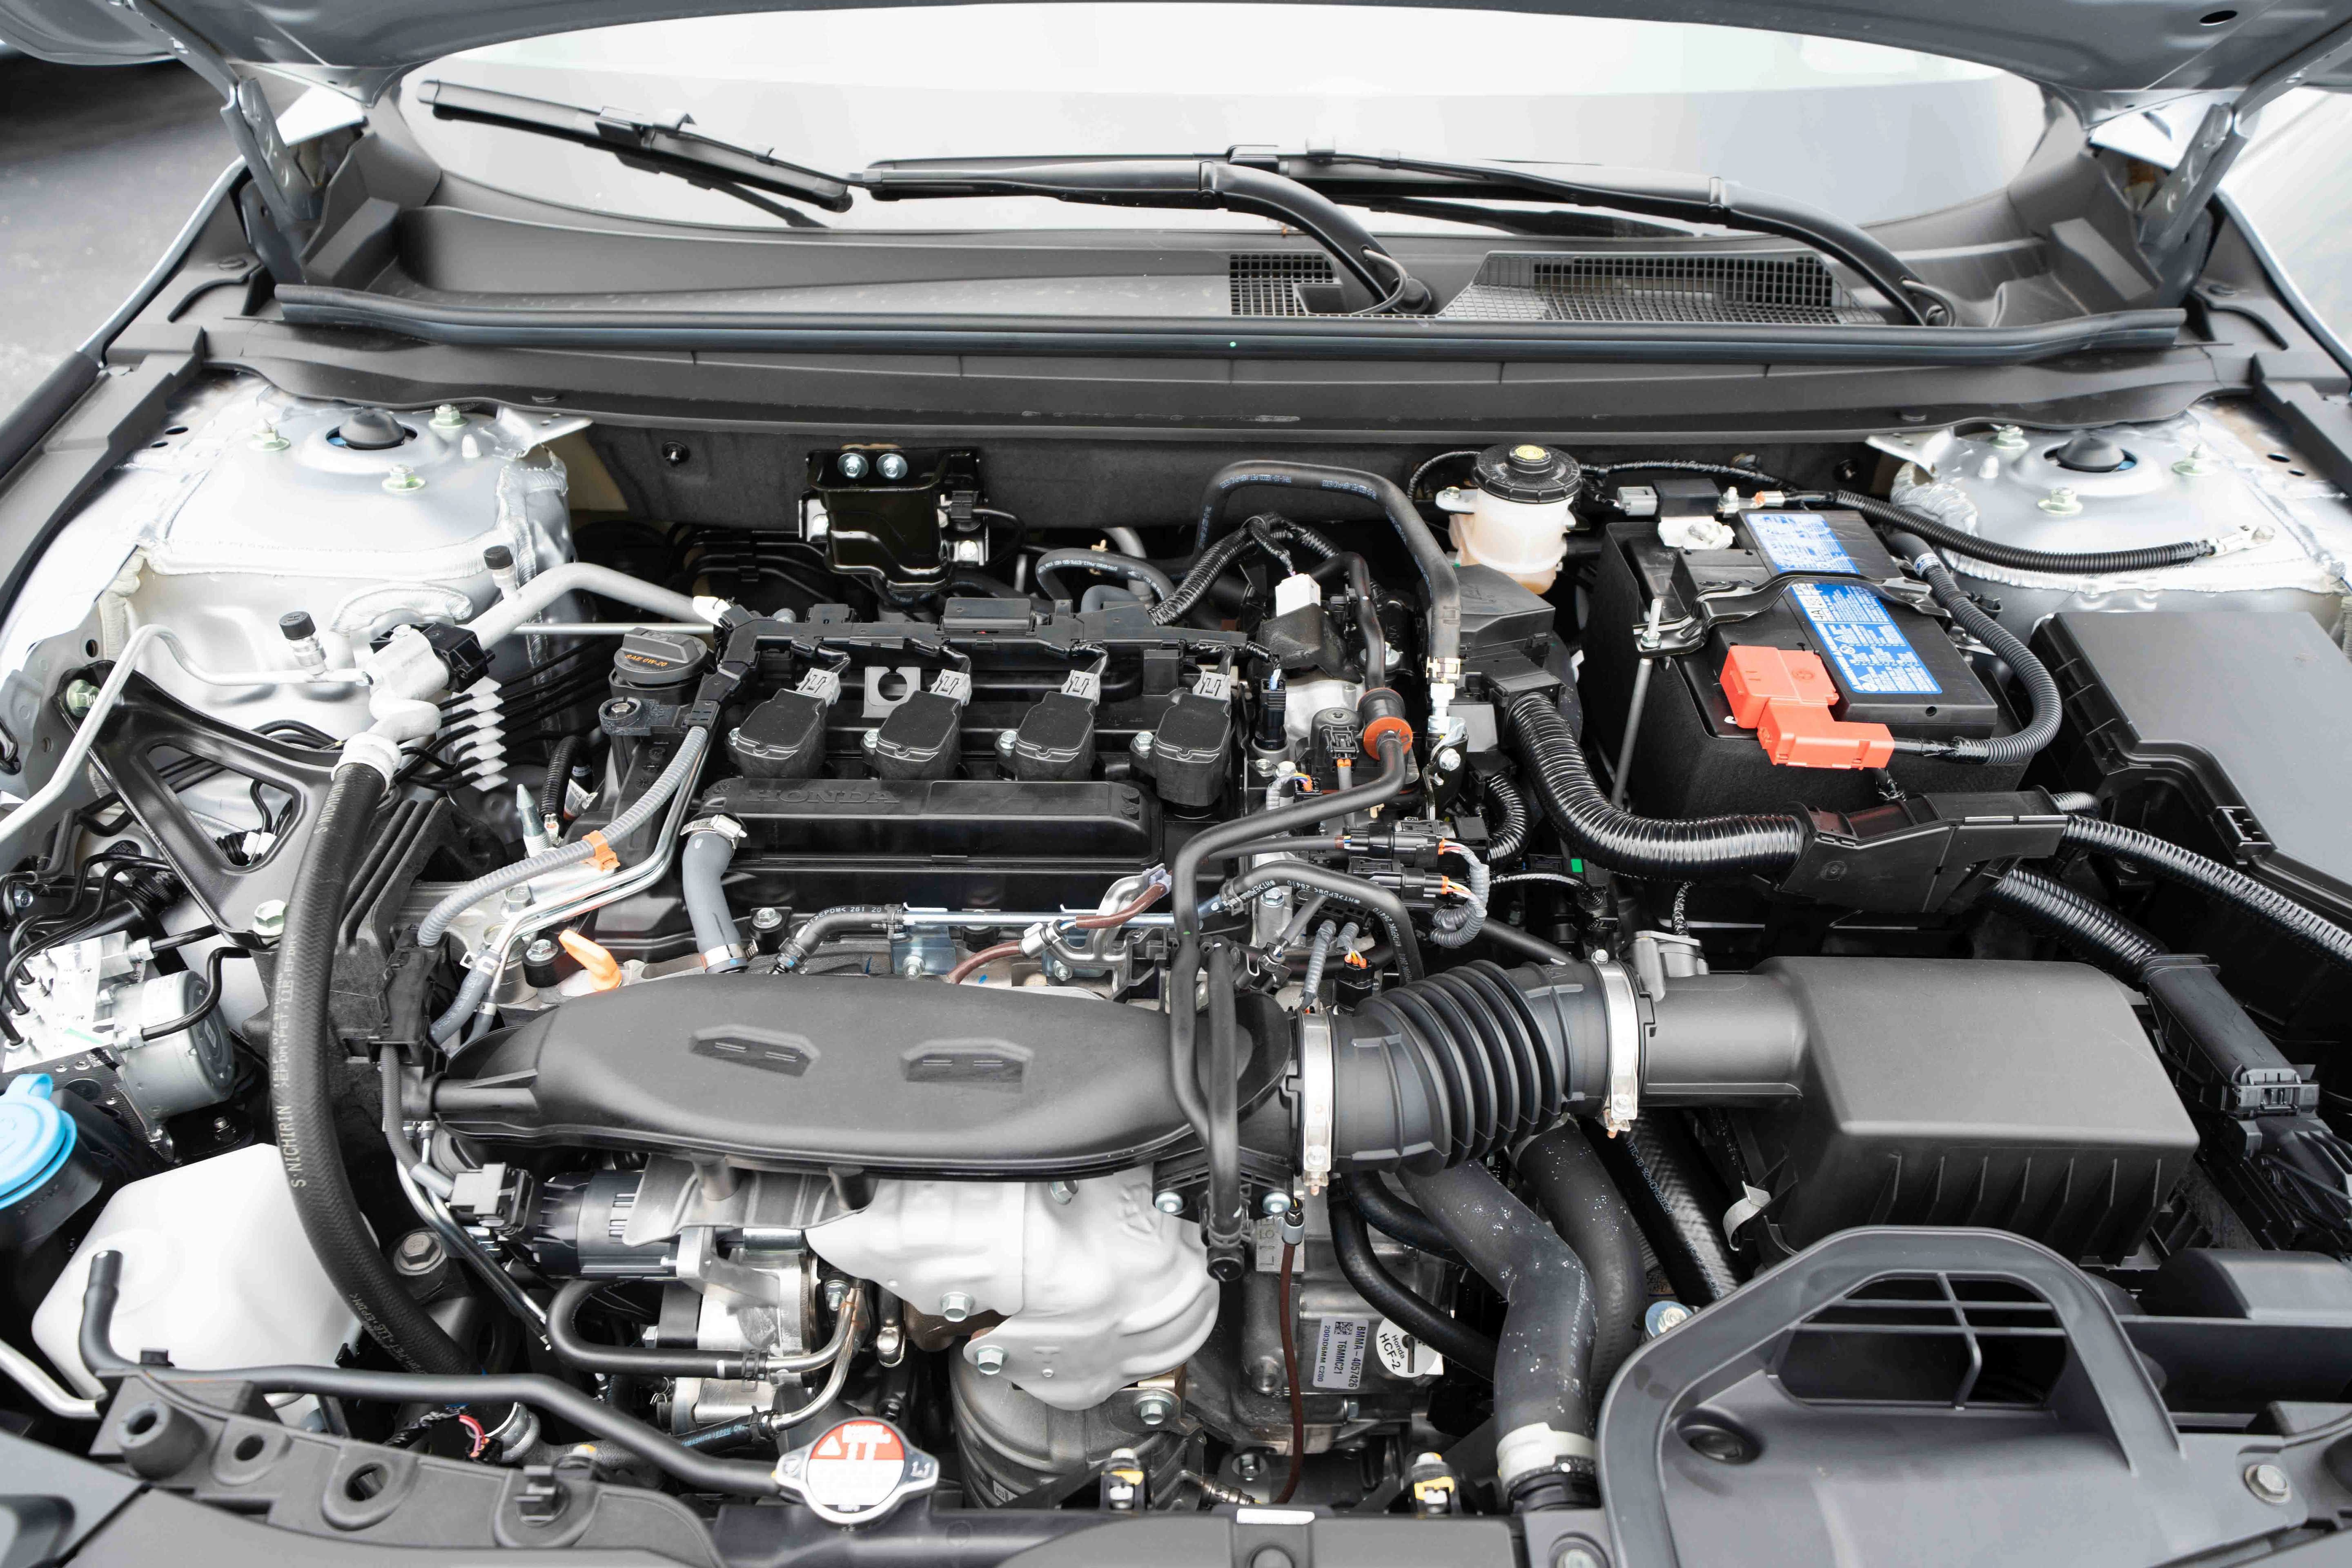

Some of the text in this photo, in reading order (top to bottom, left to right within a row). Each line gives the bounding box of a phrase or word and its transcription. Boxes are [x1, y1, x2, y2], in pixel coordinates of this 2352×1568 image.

[642, 658, 668, 667] 0W-20
[746, 789, 900, 804] HONDA
[1333, 1340, 1348, 1375] T6MMC21
[1379, 1332, 1401, 1371] HCF-2
[1391, 1334, 1405, 1360] Honda
